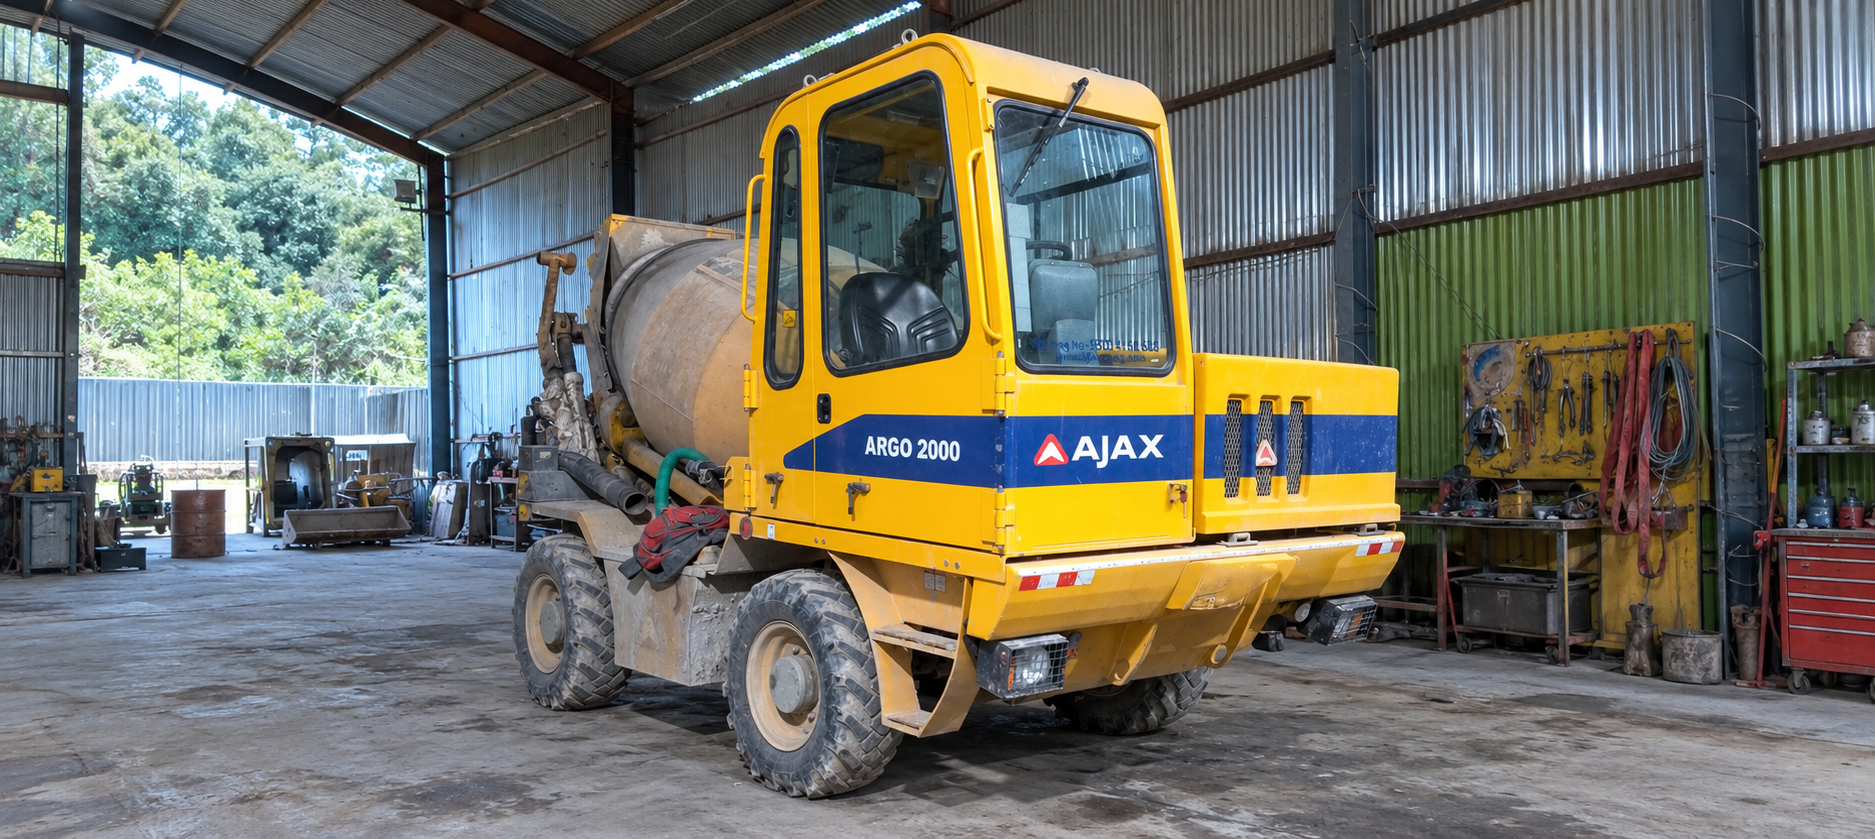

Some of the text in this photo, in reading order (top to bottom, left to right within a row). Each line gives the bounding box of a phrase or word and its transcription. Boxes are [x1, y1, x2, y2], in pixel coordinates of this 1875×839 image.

[864, 435, 961, 461] ARGO 2000
[1072, 434, 1164, 468] AJAX
